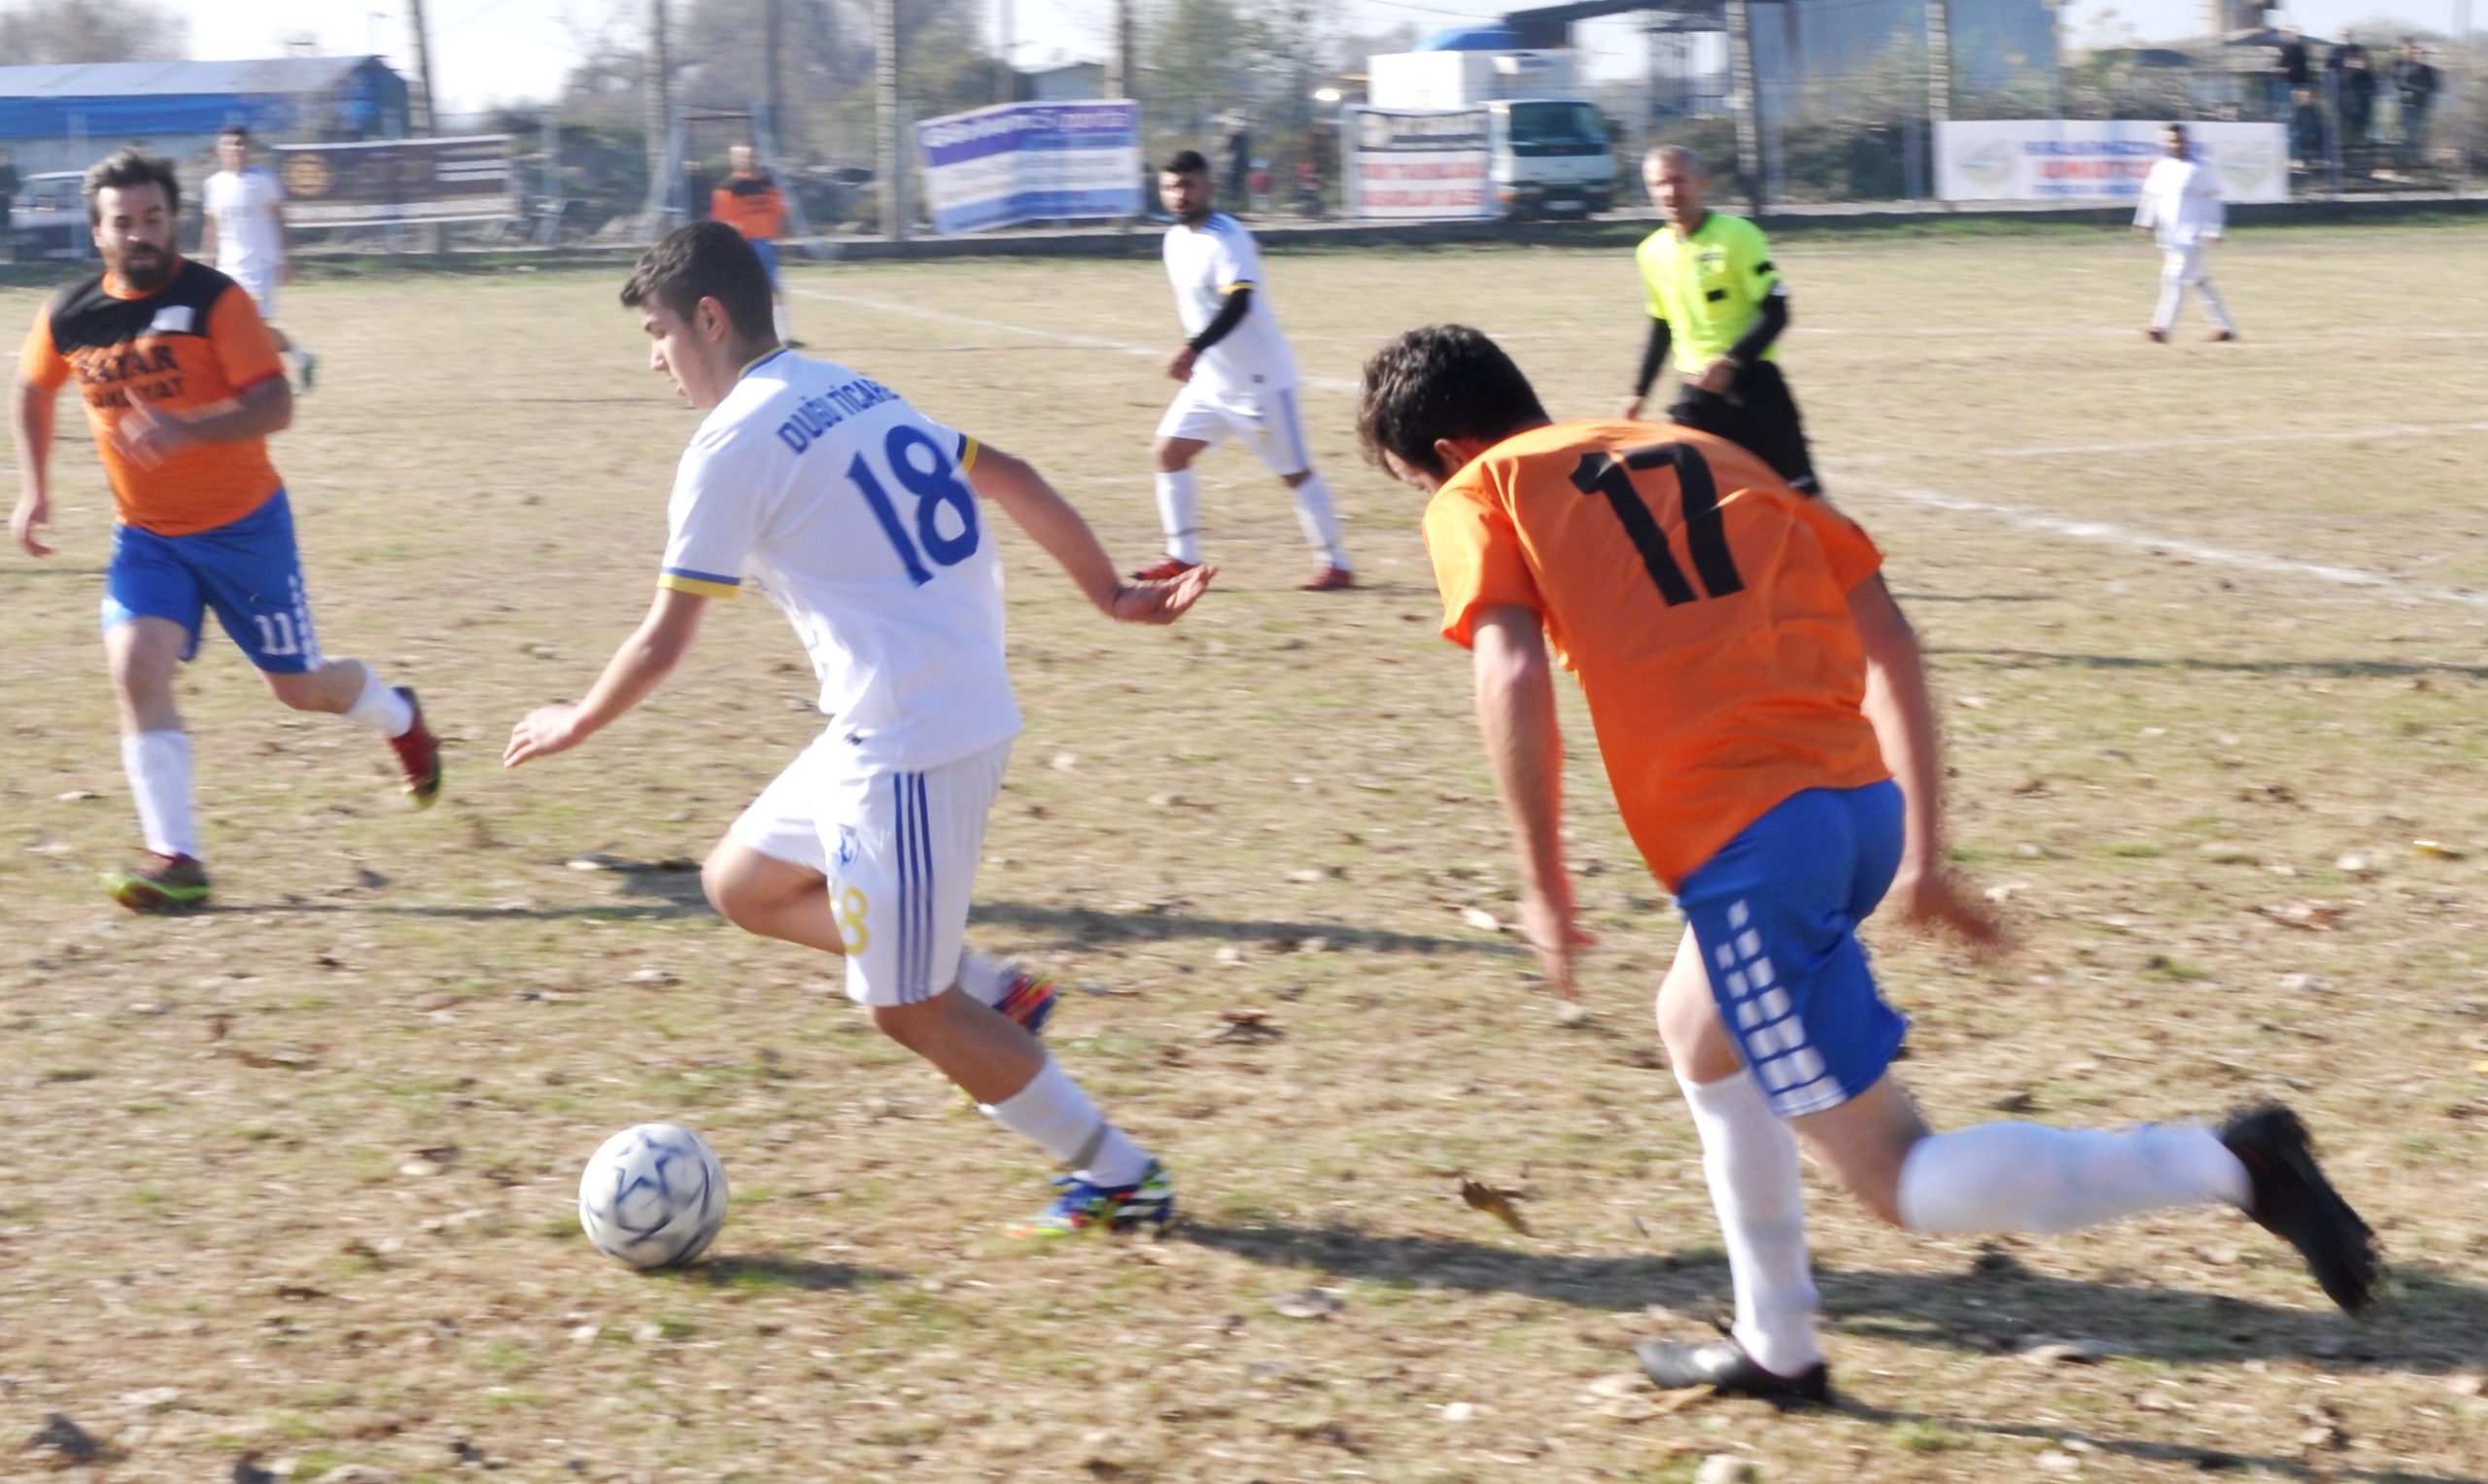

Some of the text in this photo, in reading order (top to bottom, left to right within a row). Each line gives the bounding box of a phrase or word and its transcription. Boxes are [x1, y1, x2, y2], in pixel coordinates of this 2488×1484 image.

[846, 425, 980, 587] 18
[1569, 442, 1745, 606] 17
[254, 611, 298, 655] 11
